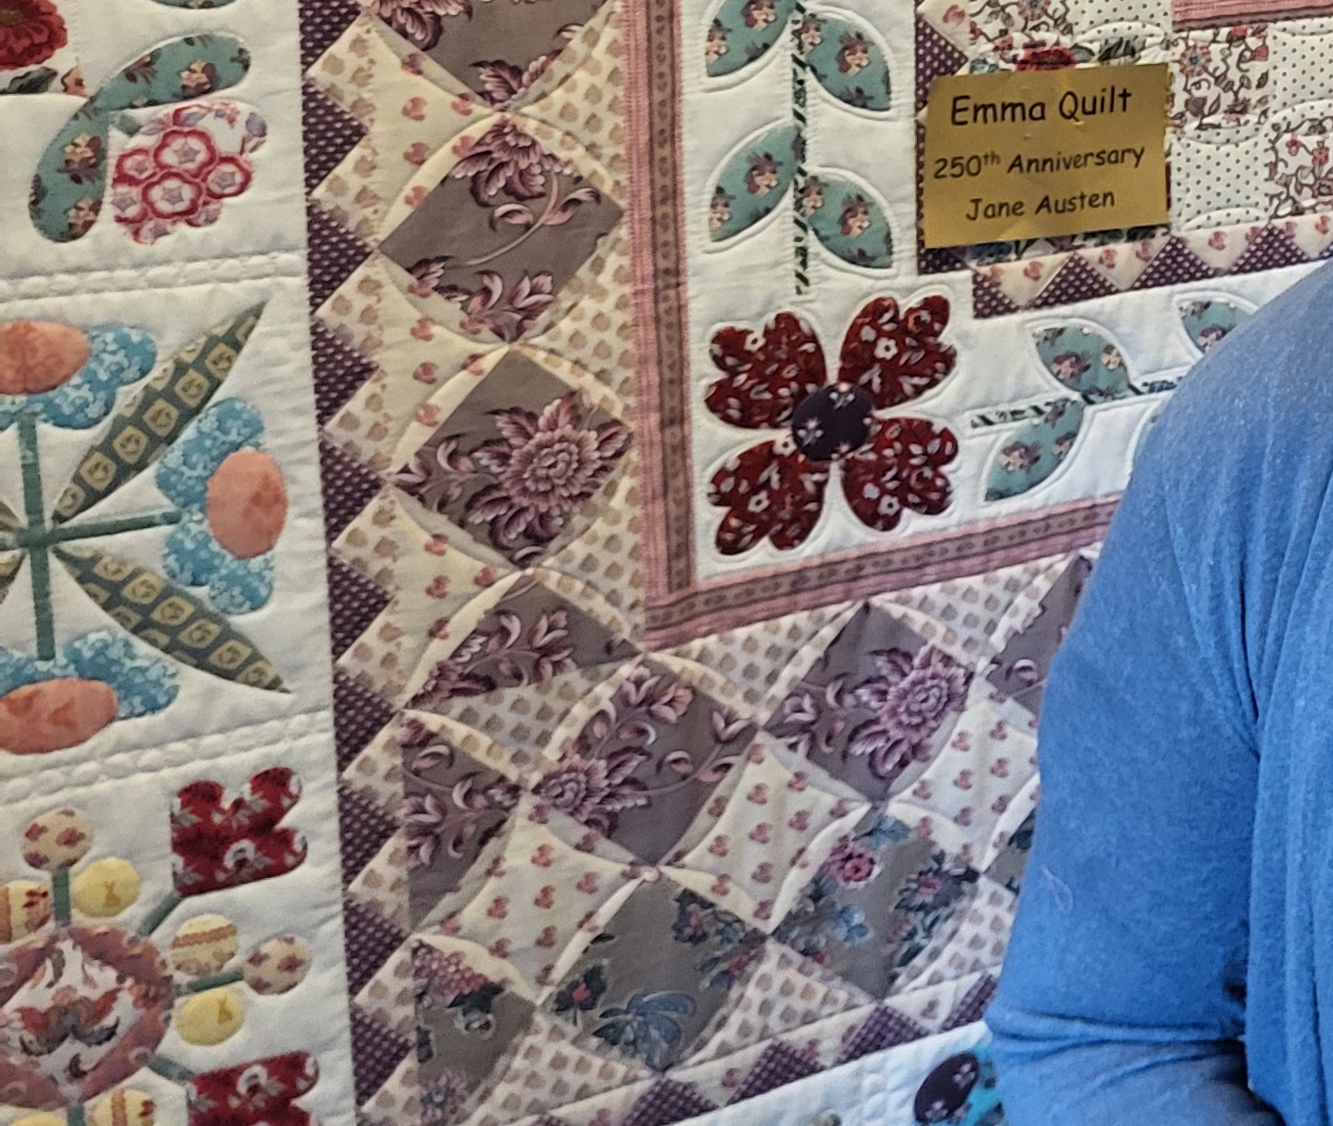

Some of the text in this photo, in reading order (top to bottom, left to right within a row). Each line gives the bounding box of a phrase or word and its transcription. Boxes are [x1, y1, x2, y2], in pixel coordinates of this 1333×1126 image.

[951, 85, 1132, 126] Emma Quilt
[933, 146, 1145, 179] 250th Anniversary
[966, 190, 1116, 221] Jane Austen
